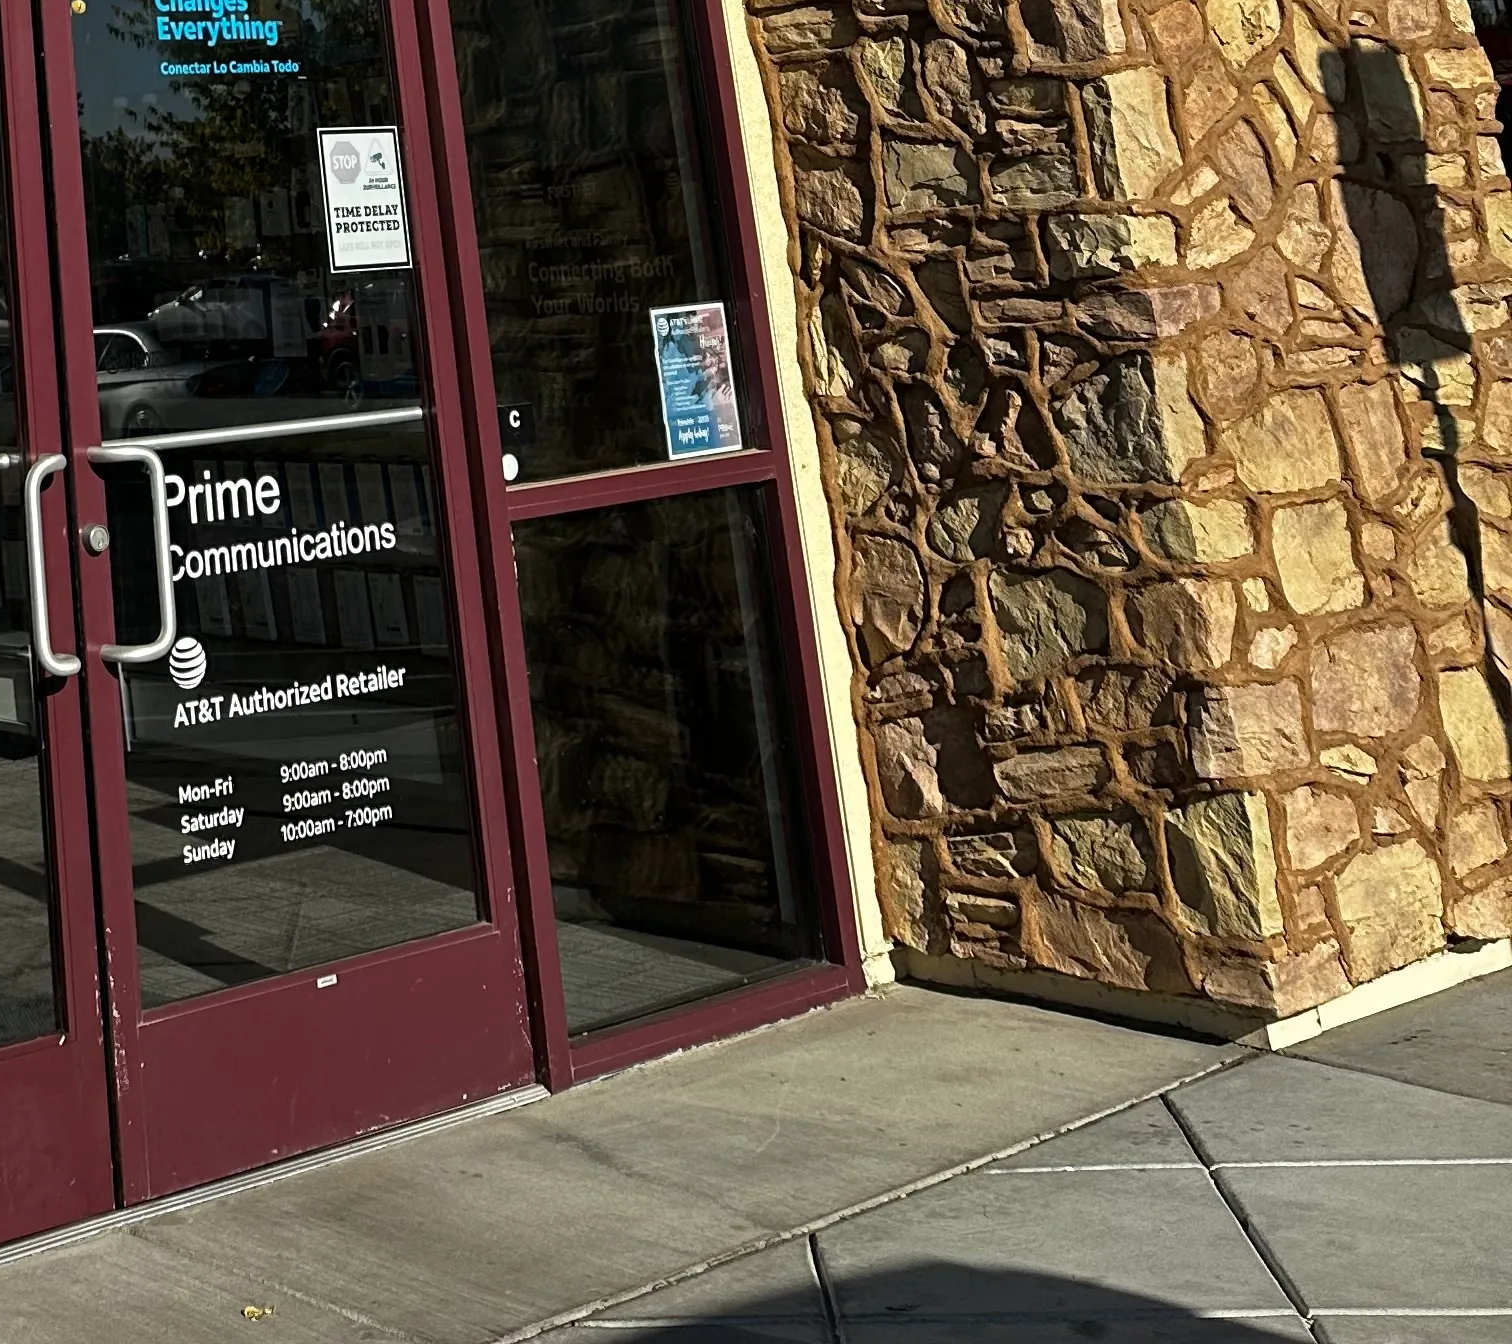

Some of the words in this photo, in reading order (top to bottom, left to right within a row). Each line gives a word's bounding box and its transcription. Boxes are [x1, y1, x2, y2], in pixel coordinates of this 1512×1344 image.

[160, 62, 212, 76] Conectar
[213, 61, 227, 74] Lo
[229, 59, 270, 73] Cambia
[332, 154, 358, 170] STOP
[334, 206, 362, 219] TIME
[364, 204, 399, 217] DELAY
[335, 220, 400, 234] PROTECTED
[509, 410, 521, 428] C
[164, 470, 281, 524] Prime
[169, 520, 397, 582] Communications
[173, 696, 224, 728] AT&T
[228, 675, 333, 718] Authorized
[336, 664, 407, 699] Retailer
[280, 760, 329, 783] 9:00am
[339, 748, 388, 772] 8:00pm
[178, 776, 234, 804] Mon-Fri
[282, 789, 332, 812] 9:00am
[342, 777, 390, 801] 8:00pm
[181, 805, 245, 834] Saturday
[280, 817, 336, 842] 10:00am
[345, 805, 393, 829] 7:00pm
[183, 838, 236, 864] Sunday
